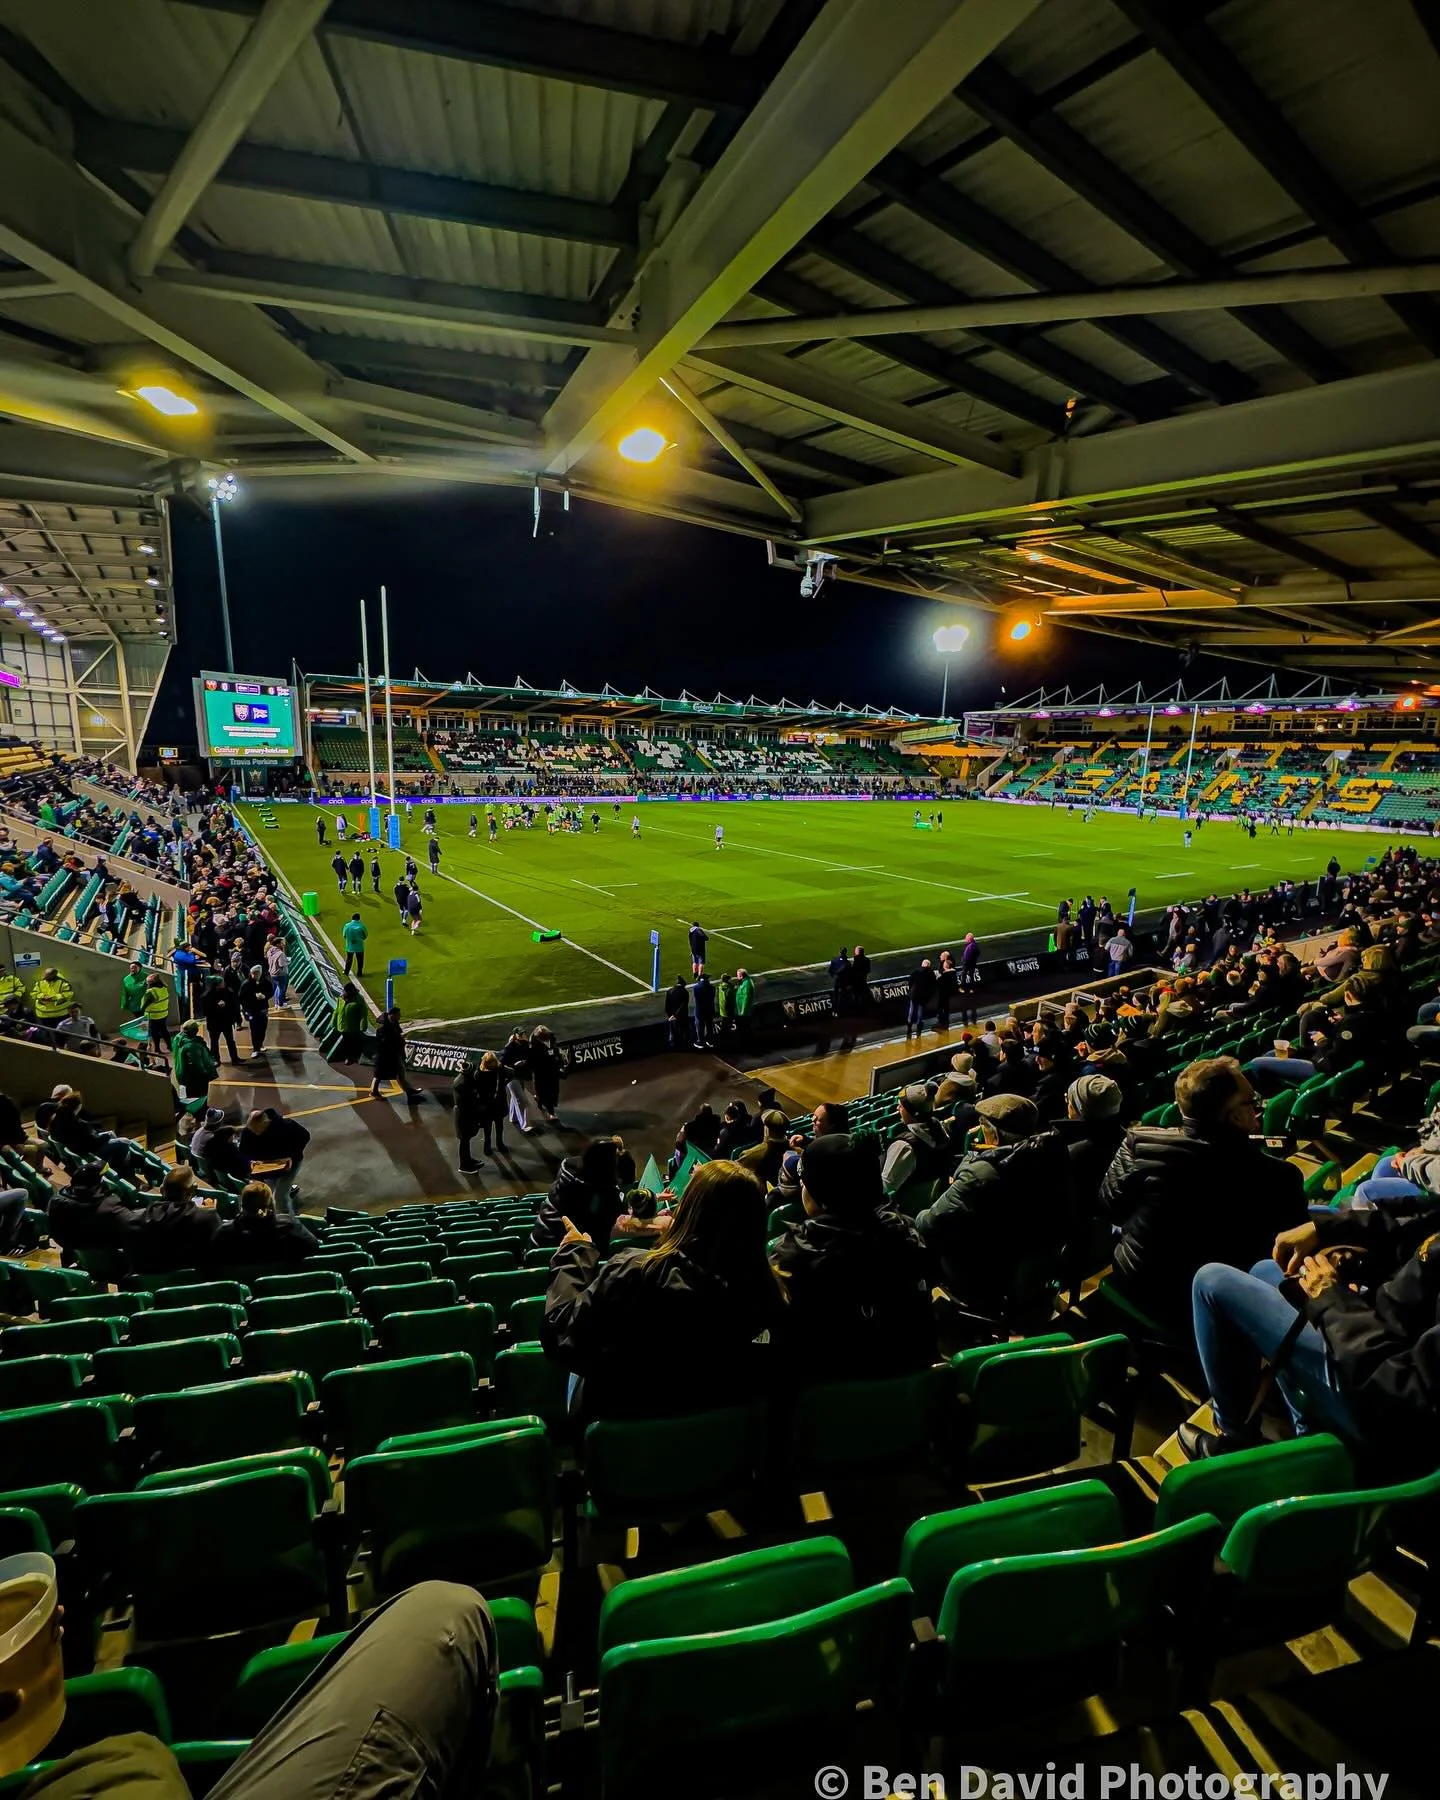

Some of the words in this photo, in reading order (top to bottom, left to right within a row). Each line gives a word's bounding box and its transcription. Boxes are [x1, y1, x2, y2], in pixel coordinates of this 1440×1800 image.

[883, 985, 911, 999] SAINT
[798, 998, 833, 1015] SAINTS
[416, 1046, 468, 1059] NORTHAMPTON
[574, 1042, 624, 1063] SAINTS
[412, 1053, 466, 1073] SAINTS
